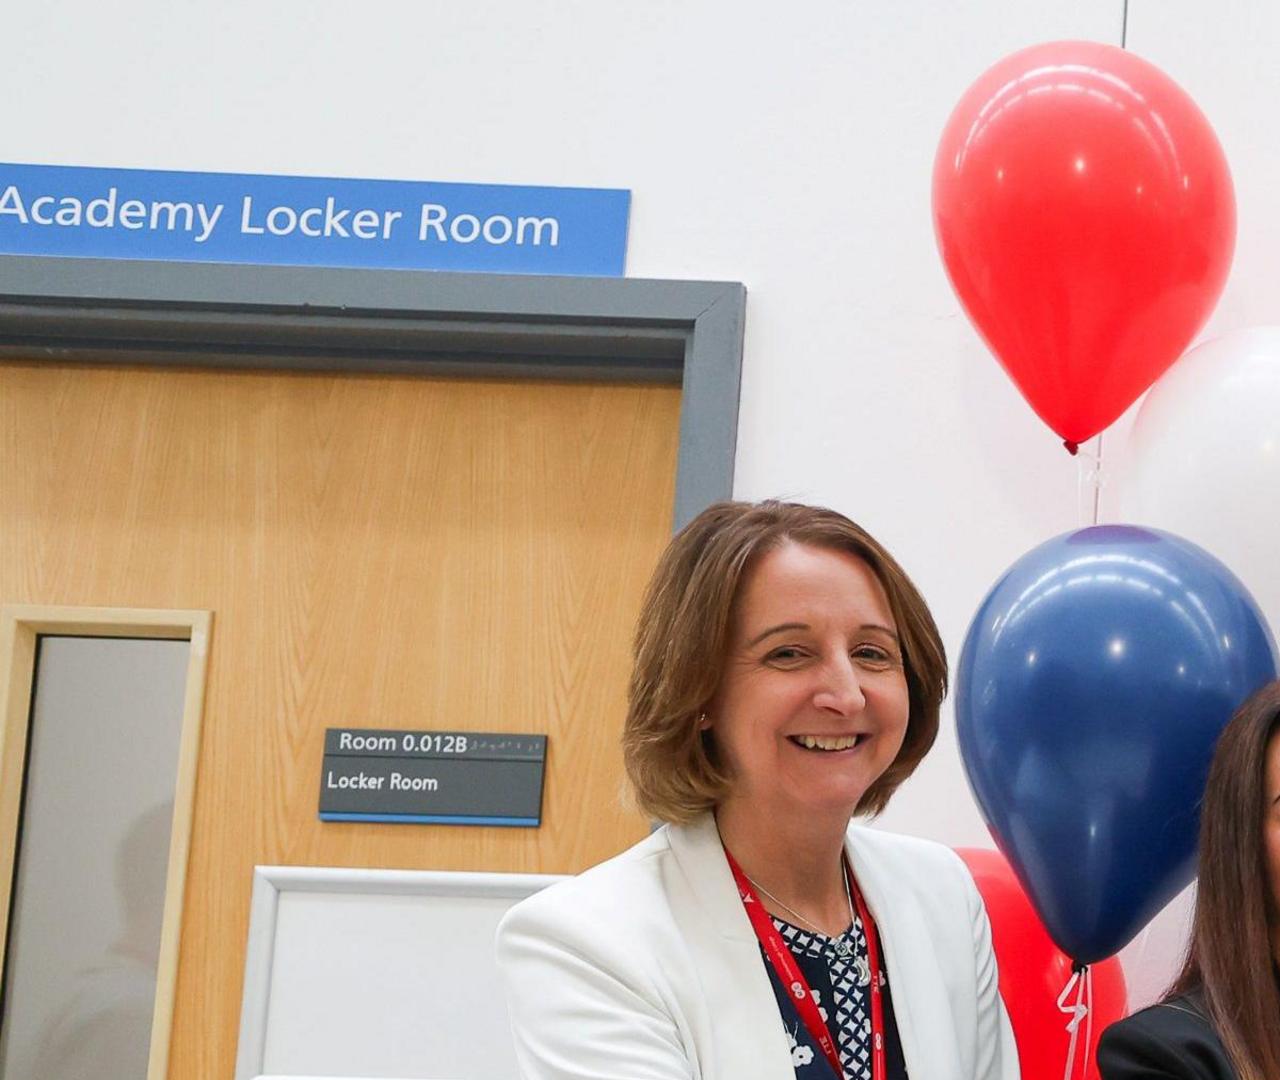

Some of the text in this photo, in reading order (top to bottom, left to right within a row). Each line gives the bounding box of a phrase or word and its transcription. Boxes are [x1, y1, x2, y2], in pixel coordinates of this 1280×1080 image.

[0, 186, 560, 246] Academy Locker Room
[340, 733, 468, 753] Room 0.012B
[327, 771, 439, 792] Locker Room
